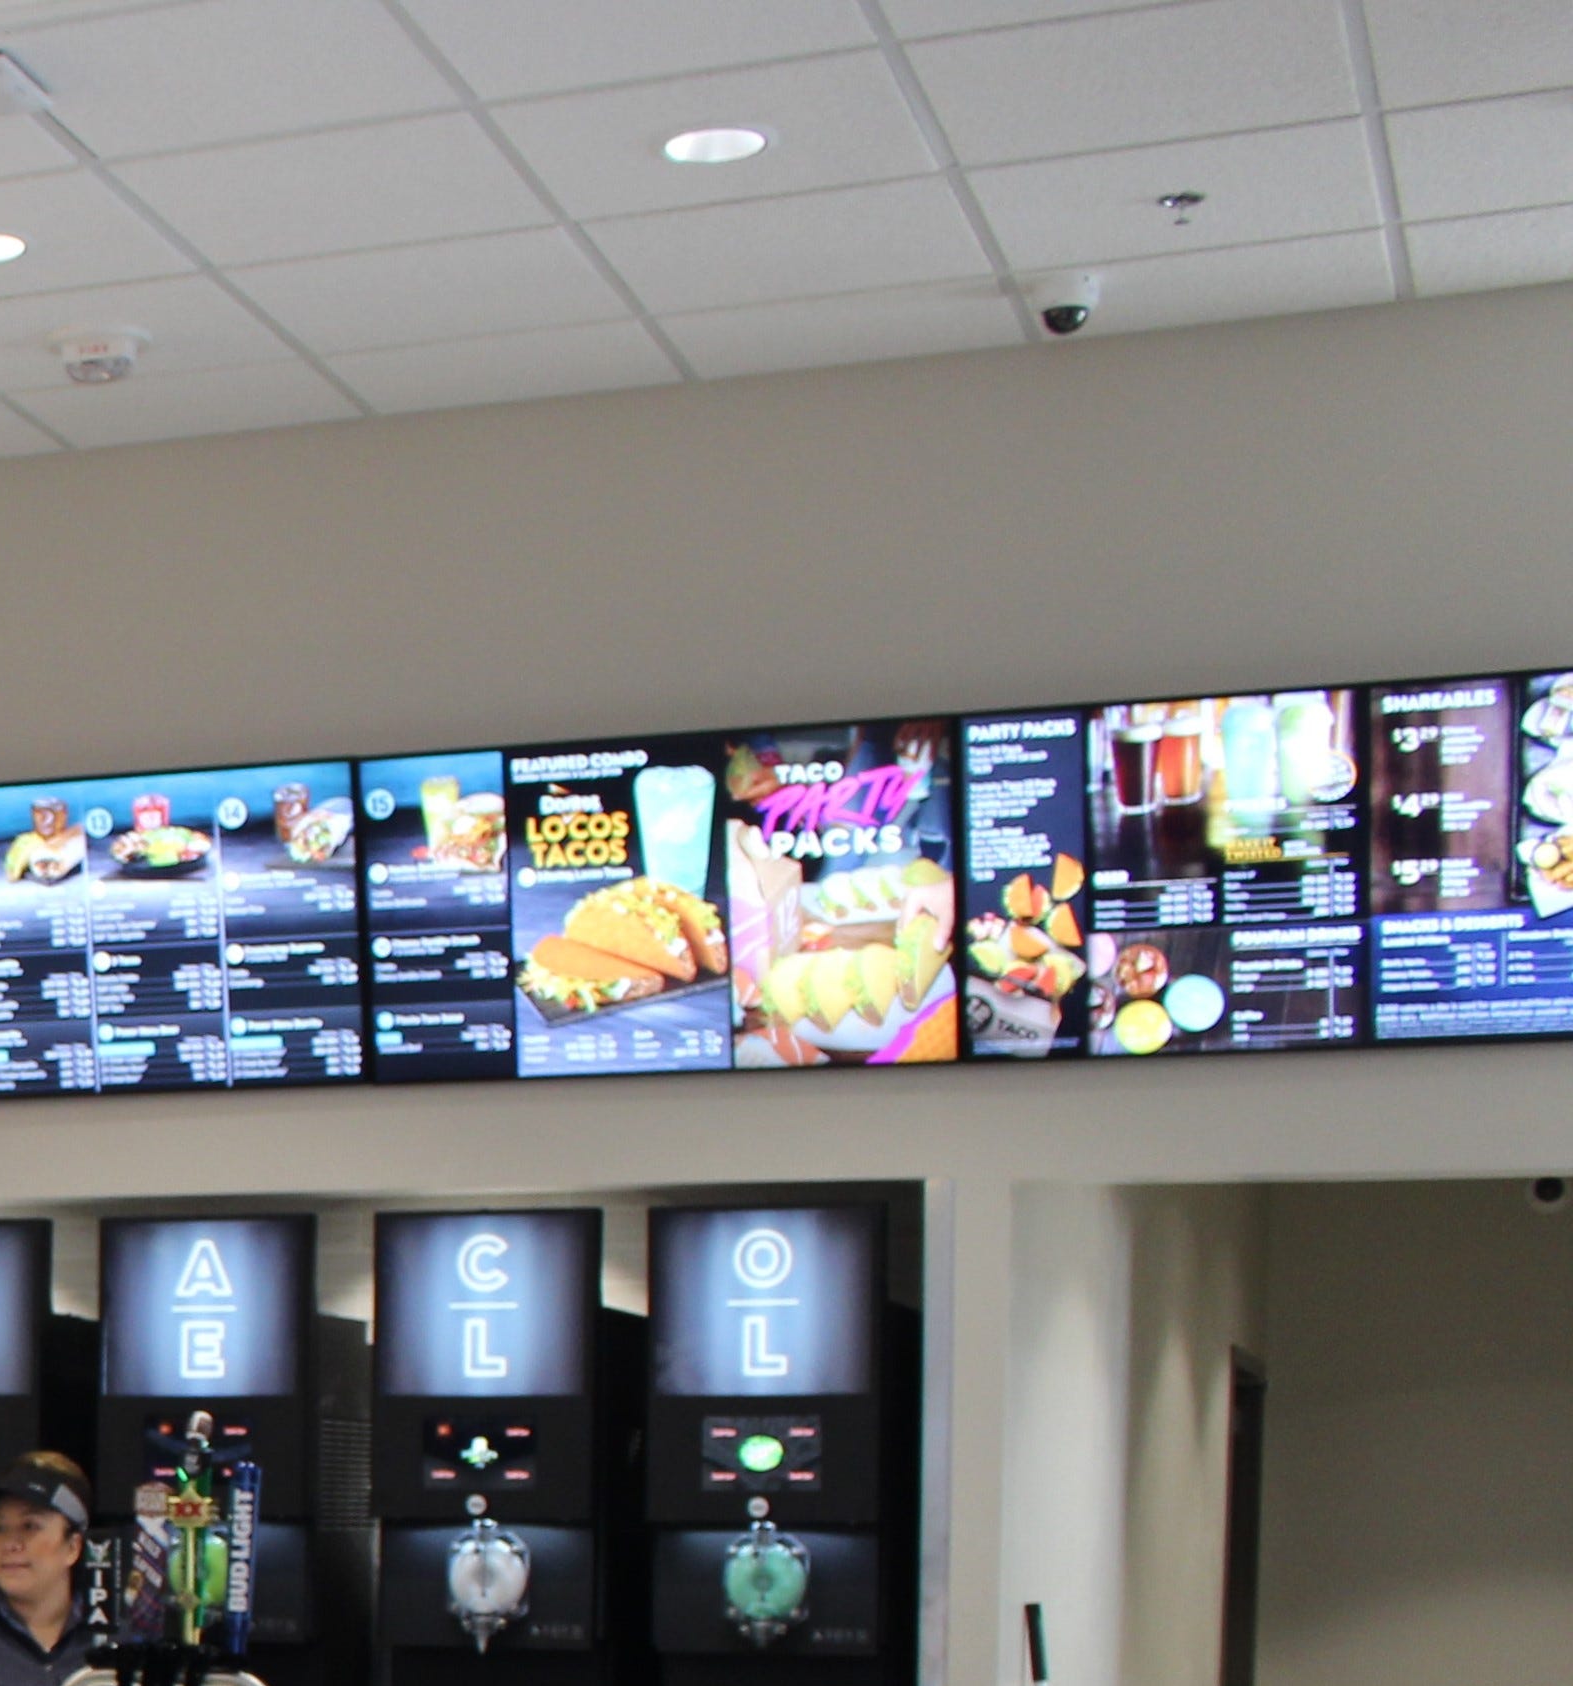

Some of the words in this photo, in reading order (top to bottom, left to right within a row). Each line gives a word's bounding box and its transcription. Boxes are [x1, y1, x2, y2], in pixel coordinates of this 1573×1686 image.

[1382, 689, 1496, 714] SHAREABLES
[968, 722, 1021, 743] PARTY
[1022, 718, 1077, 739] PACKS
[510, 754, 588, 774] FEATURED
[590, 749, 648, 768] COMBO
[774, 760, 844, 783] TACO
[223, 804, 241, 821] 14
[371, 797, 389, 812] 15
[756, 764, 925, 842] PARTY
[90, 814, 108, 830] 13
[526, 811, 630, 845] LOCOS
[530, 838, 628, 868] TACOS
[770, 824, 903, 859] PACKS
[1232, 929, 1305, 946] FOUNTAIN
[1306, 925, 1362, 942] DRINKS
[1381, 918, 1439, 935] SNACKS
[1441, 917, 1453, 931] &
[1454, 913, 1524, 931] DESSERTS
[998, 1018, 1039, 1039] TACO
[175, 1238, 232, 1298] A
[457, 1233, 509, 1292] C
[733, 1228, 793, 1289] O
[180, 1319, 226, 1379] E
[463, 1317, 508, 1378] L
[743, 1315, 789, 1377] L
[175, 1502, 203, 1517] XX
[231, 1489, 253, 1560] LIGHT
[87, 1568, 109, 1625] IPA
[228, 1561, 249, 1612] BUD
